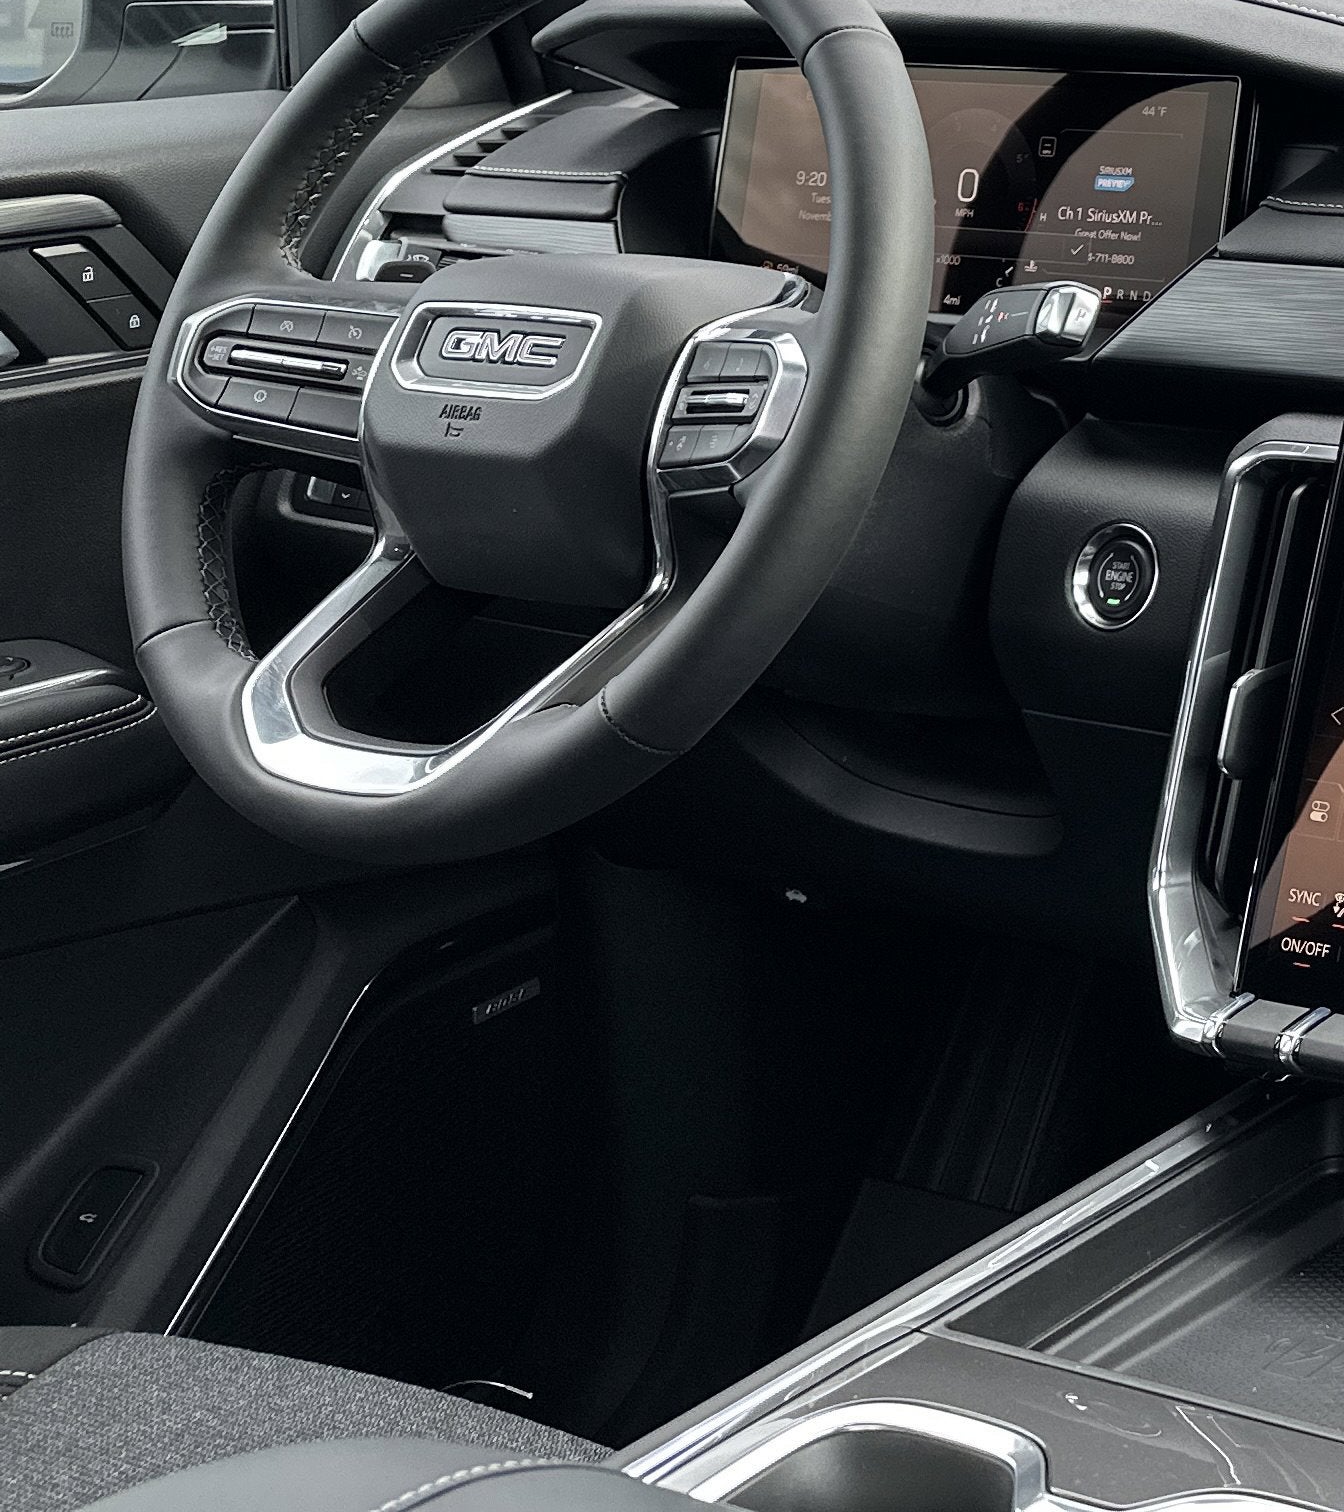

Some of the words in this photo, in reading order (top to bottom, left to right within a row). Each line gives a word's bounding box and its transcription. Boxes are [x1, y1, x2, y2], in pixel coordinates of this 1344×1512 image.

[1141, 105, 1156, 117] 44
[1099, 165, 1133, 176] SIRIUSXM
[795, 170, 828, 187] 9:20
[957, 168, 980, 203] 0
[954, 208, 974, 218] MPH
[1039, 212, 1048, 222] H
[1057, 206, 1074, 220] Ch
[1076, 207, 1083, 221] 1
[1086, 208, 1137, 224] SiriusXM
[1098, 229, 1120, 240] Offer
[1120, 231, 1142, 242] Now!
[943, 294, 961, 305] 4mi
[1102, 287, 1113, 299] P
[1117, 289, 1124, 300] R
[1129, 290, 1138, 301] N
[1142, 291, 1151, 301] D
[439, 327, 566, 368] GMC
[439, 404, 482, 421] AIRBAG
[1112, 561, 1131, 571] START
[1105, 569, 1134, 583] ENGINE
[1110, 582, 1126, 591] STOP
[1288, 888, 1322, 907] SYNC
[1281, 937, 1331, 958] ON/OFF
